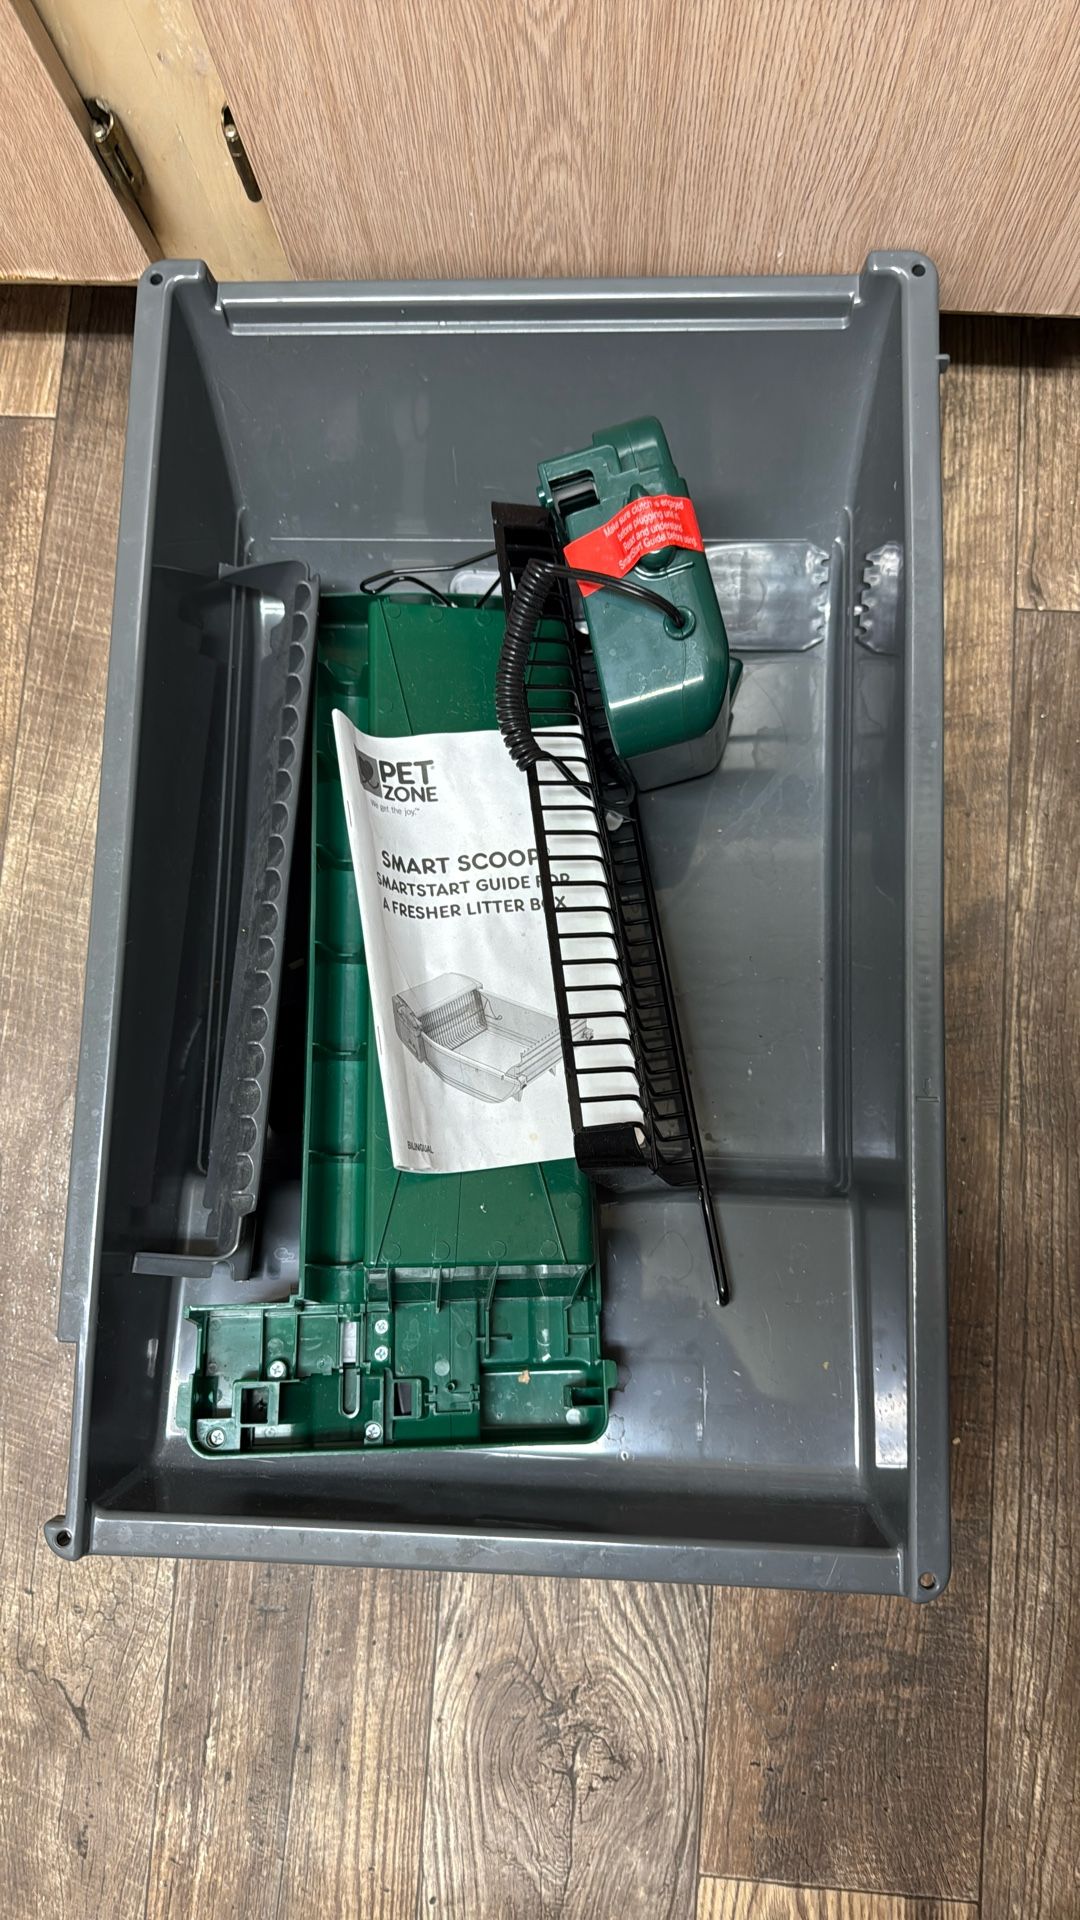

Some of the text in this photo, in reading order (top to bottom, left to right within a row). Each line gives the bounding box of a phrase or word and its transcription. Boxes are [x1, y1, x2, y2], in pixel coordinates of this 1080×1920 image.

[618, 511, 631, 525] sure
[631, 501, 653, 515] clutch
[633, 510, 664, 529] plugging
[635, 527, 650, 540] and
[643, 533, 666, 548] Guide
[378, 759, 434, 785] PET
[382, 784, 439, 803] ZONE
[391, 805, 402, 814] the
[381, 848, 539, 875] SMART SCOOP
[376, 871, 470, 897] SMARTSTART
[476, 875, 531, 892] GUIDE
[383, 895, 567, 920] A FRESHER LITTER BX
